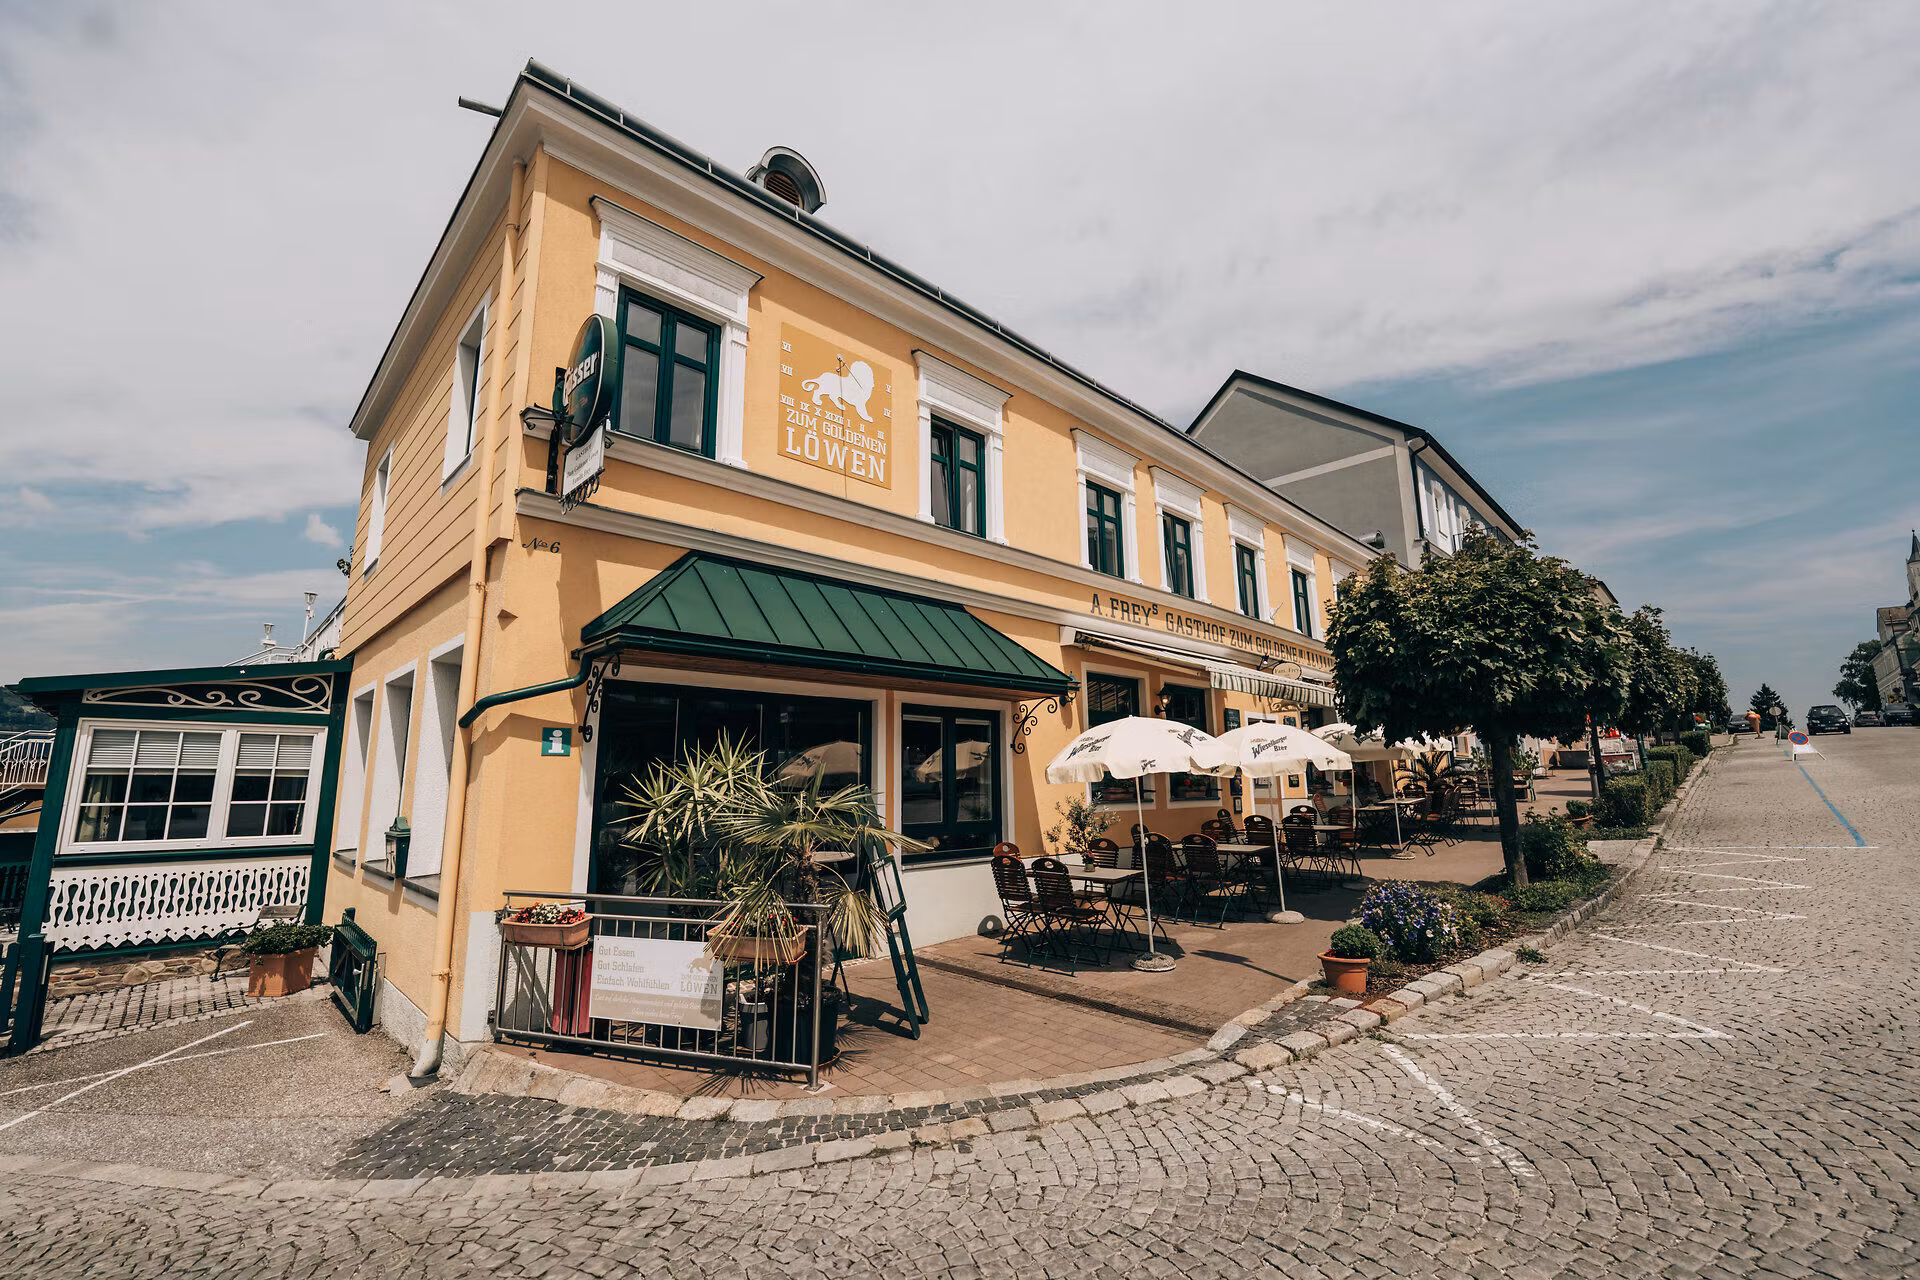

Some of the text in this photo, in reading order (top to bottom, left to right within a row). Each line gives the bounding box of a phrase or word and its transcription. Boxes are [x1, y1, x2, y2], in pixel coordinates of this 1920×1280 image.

[786, 408, 887, 457] ZUM GOLDENEN
[785, 426, 887, 483] LÖWEN
[549, 541, 561, 554] 6
[1165, 612, 1226, 644] GASTHOF
[1229, 628, 1253, 652] ZUM
[1251, 735, 1288, 759] Wieselburger
[598, 945, 635, 957] Gut Essen
[597, 960, 645, 974] Gut Schlafen
[596, 974, 670, 990] Einfach Wohlfühlen
[680, 980, 718, 995] LÖWEN
